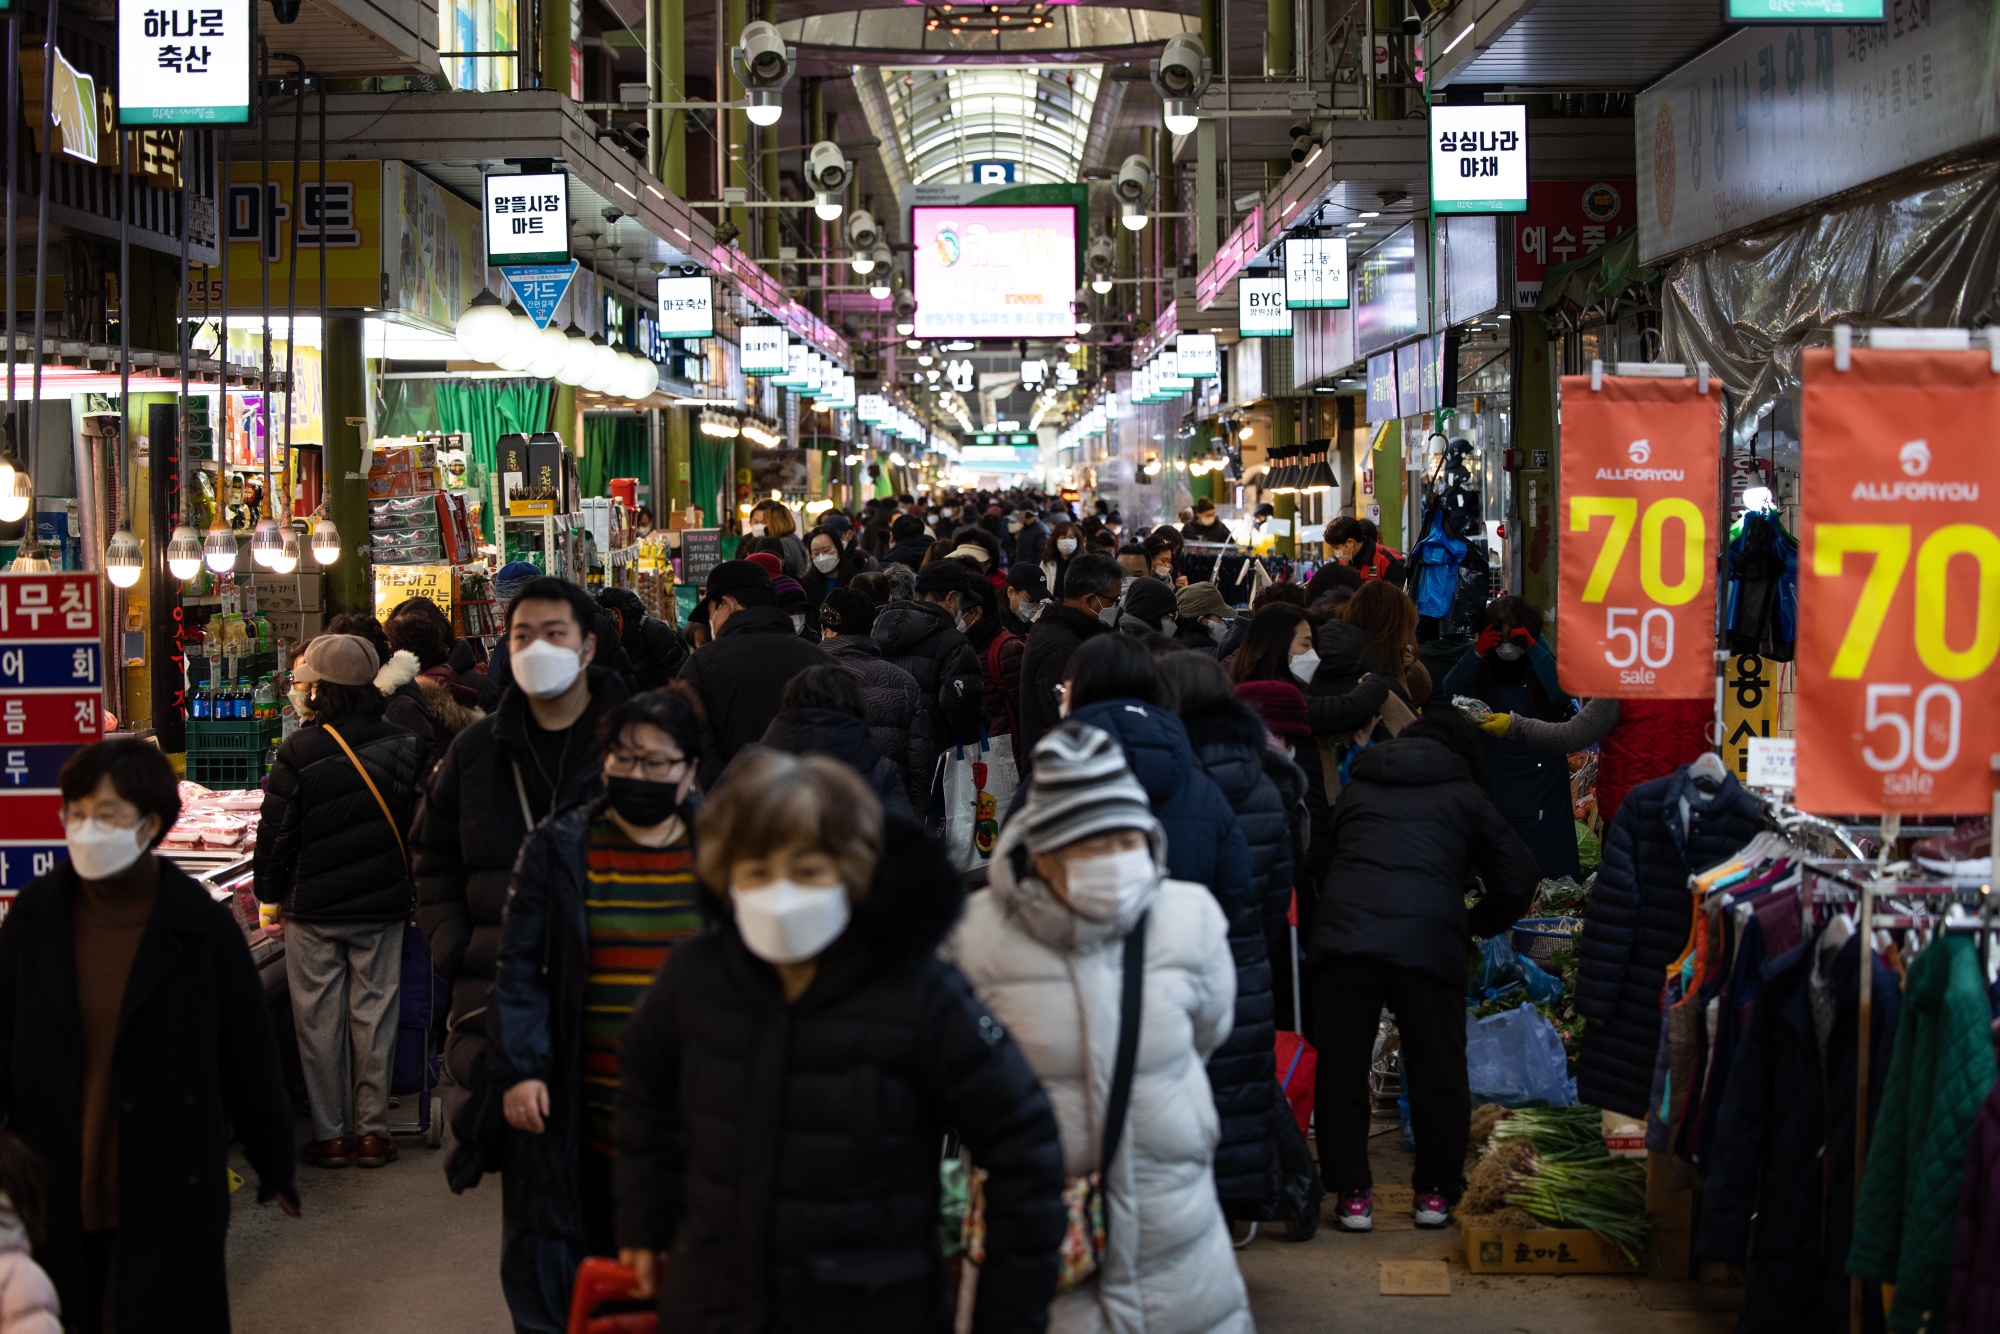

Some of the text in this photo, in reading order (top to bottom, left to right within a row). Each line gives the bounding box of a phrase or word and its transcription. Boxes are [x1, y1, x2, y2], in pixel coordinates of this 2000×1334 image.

[143, 8, 225, 38] 하나로
[157, 44, 212, 74] 축산
[1439, 130, 1520, 152] 싱싱나라
[1460, 156, 1499, 178] 야채
[494, 195, 560, 214] 알뜰시장
[227, 182, 360, 262] 마트
[512, 216, 544, 235] 마트
[523, 281, 558, 301] 카드
[1249, 292, 1283, 307] BYC
[527, 300, 555, 309] 간편결제
[663, 297, 708, 312] 마포축산
[1596, 467, 1685, 482] ALLFORYOU
[1851, 481, 1980, 501] ALLFORYOU
[1569, 496, 1706, 607] 70
[378, 573, 437, 587] 저렴하고
[0, 583, 93, 631] 무침
[1812, 523, 2000, 681] 70
[1620, 667, 1656, 685] sale
[1882, 767, 1935, 796] sale
